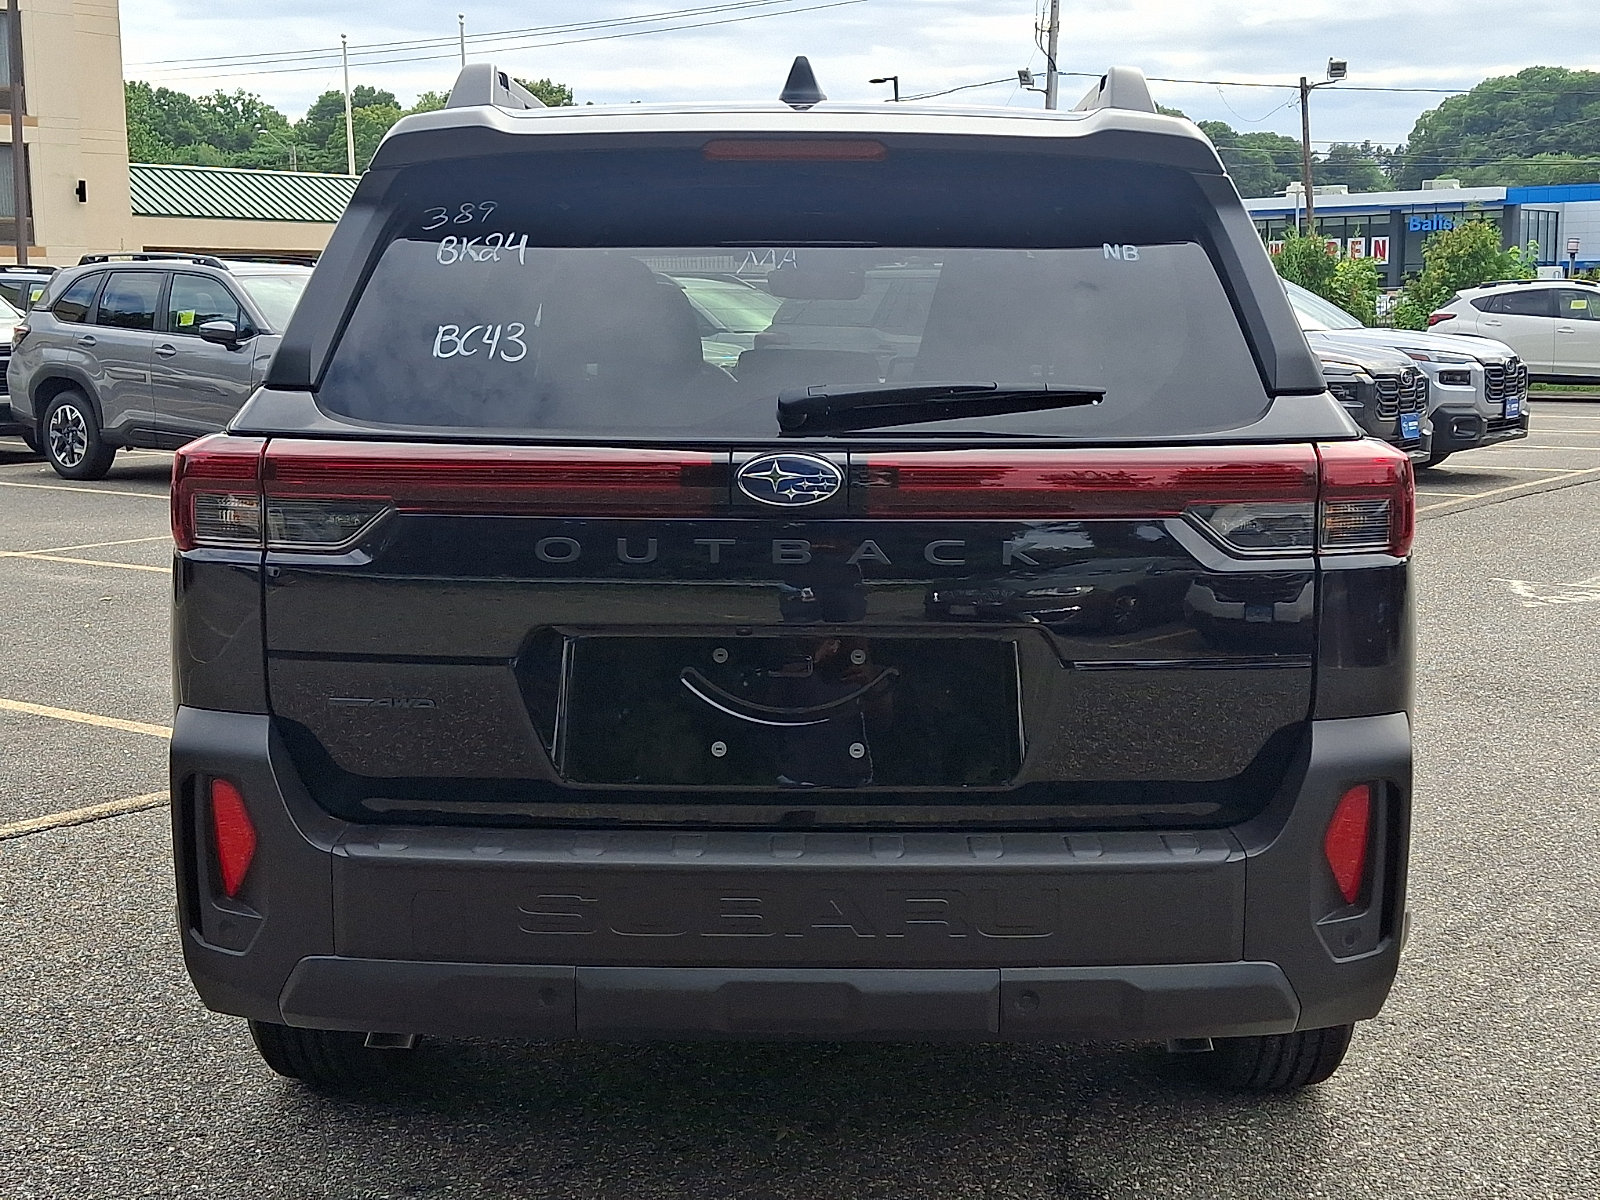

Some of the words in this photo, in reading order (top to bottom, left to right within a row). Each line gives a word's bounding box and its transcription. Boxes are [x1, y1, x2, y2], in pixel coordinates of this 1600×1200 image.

[422, 201, 498, 230] 389
[1409, 214, 1454, 232] Balis
[436, 232, 529, 265] BK24
[1103, 243, 1140, 260] NB
[432, 322, 528, 362] BC43
[534, 536, 1040, 566] OUTBACK
[367, 696, 437, 709] AWD
[517, 886, 1061, 938] SUBARU
